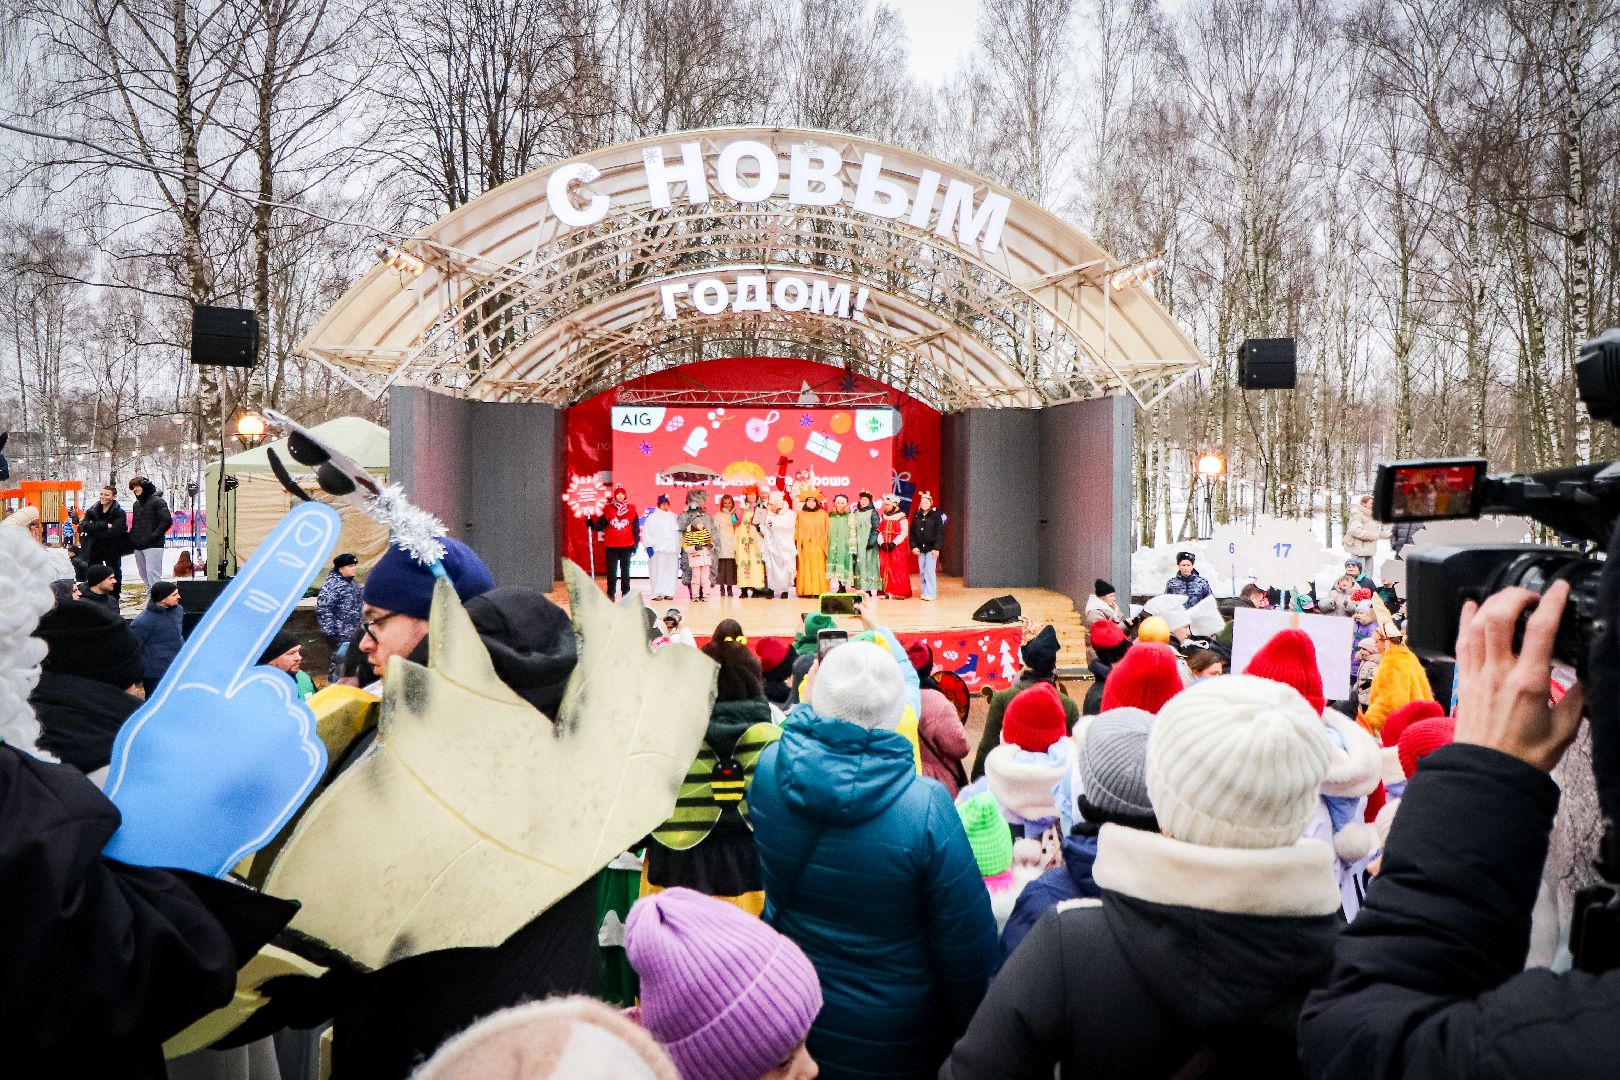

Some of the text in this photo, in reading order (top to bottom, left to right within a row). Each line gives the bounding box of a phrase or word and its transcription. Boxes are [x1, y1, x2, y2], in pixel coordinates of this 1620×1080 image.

[546, 140, 1011, 253] С НОВЫМ
[660, 275, 870, 320] ГОДОМ!
[621, 412, 652, 426] AIG
[1228, 542, 1235, 554] 6
[1273, 542, 1292, 558] 17
